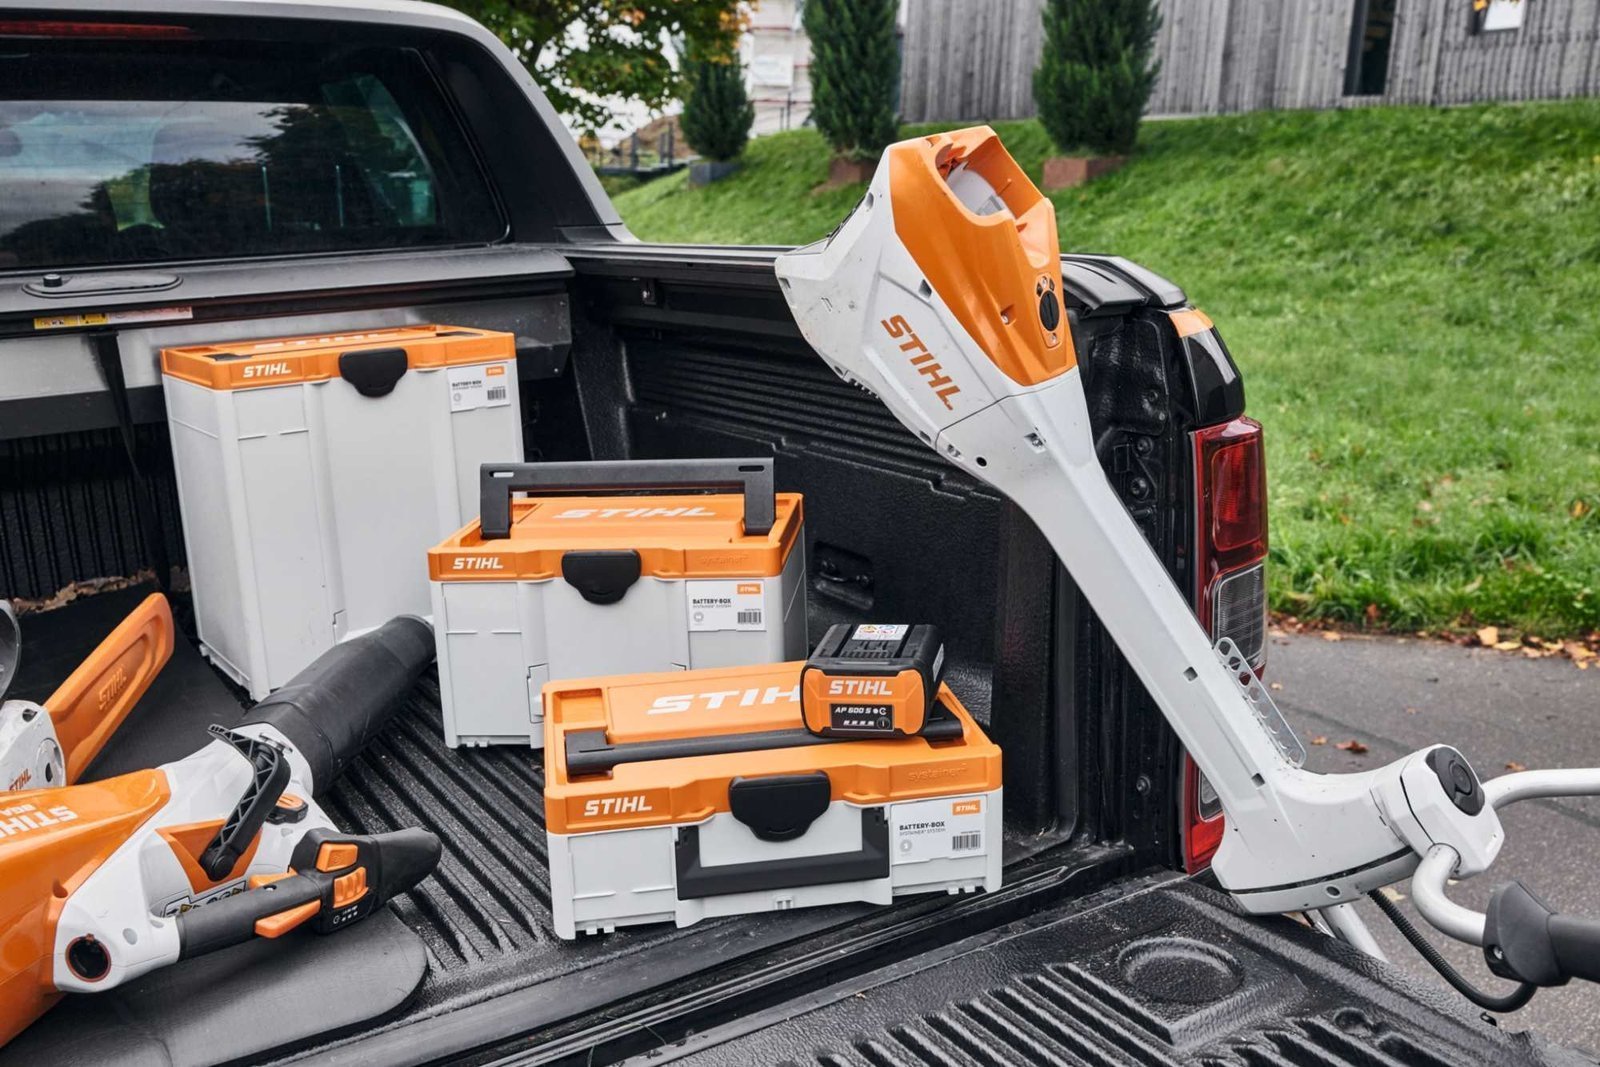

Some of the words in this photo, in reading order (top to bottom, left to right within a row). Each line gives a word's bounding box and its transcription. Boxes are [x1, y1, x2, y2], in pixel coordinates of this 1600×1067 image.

[880, 314, 961, 411] STIHL
[243, 363, 292, 378] STIHL
[553, 507, 716, 518] STIHL
[453, 557, 504, 569] STIHL
[829, 680, 893, 695] STIHL
[646, 685, 802, 714] STIH
[584, 795, 652, 817] STIHL
[0, 805, 78, 839] STIH
[899, 821, 945, 831] BATTERY-BOX
